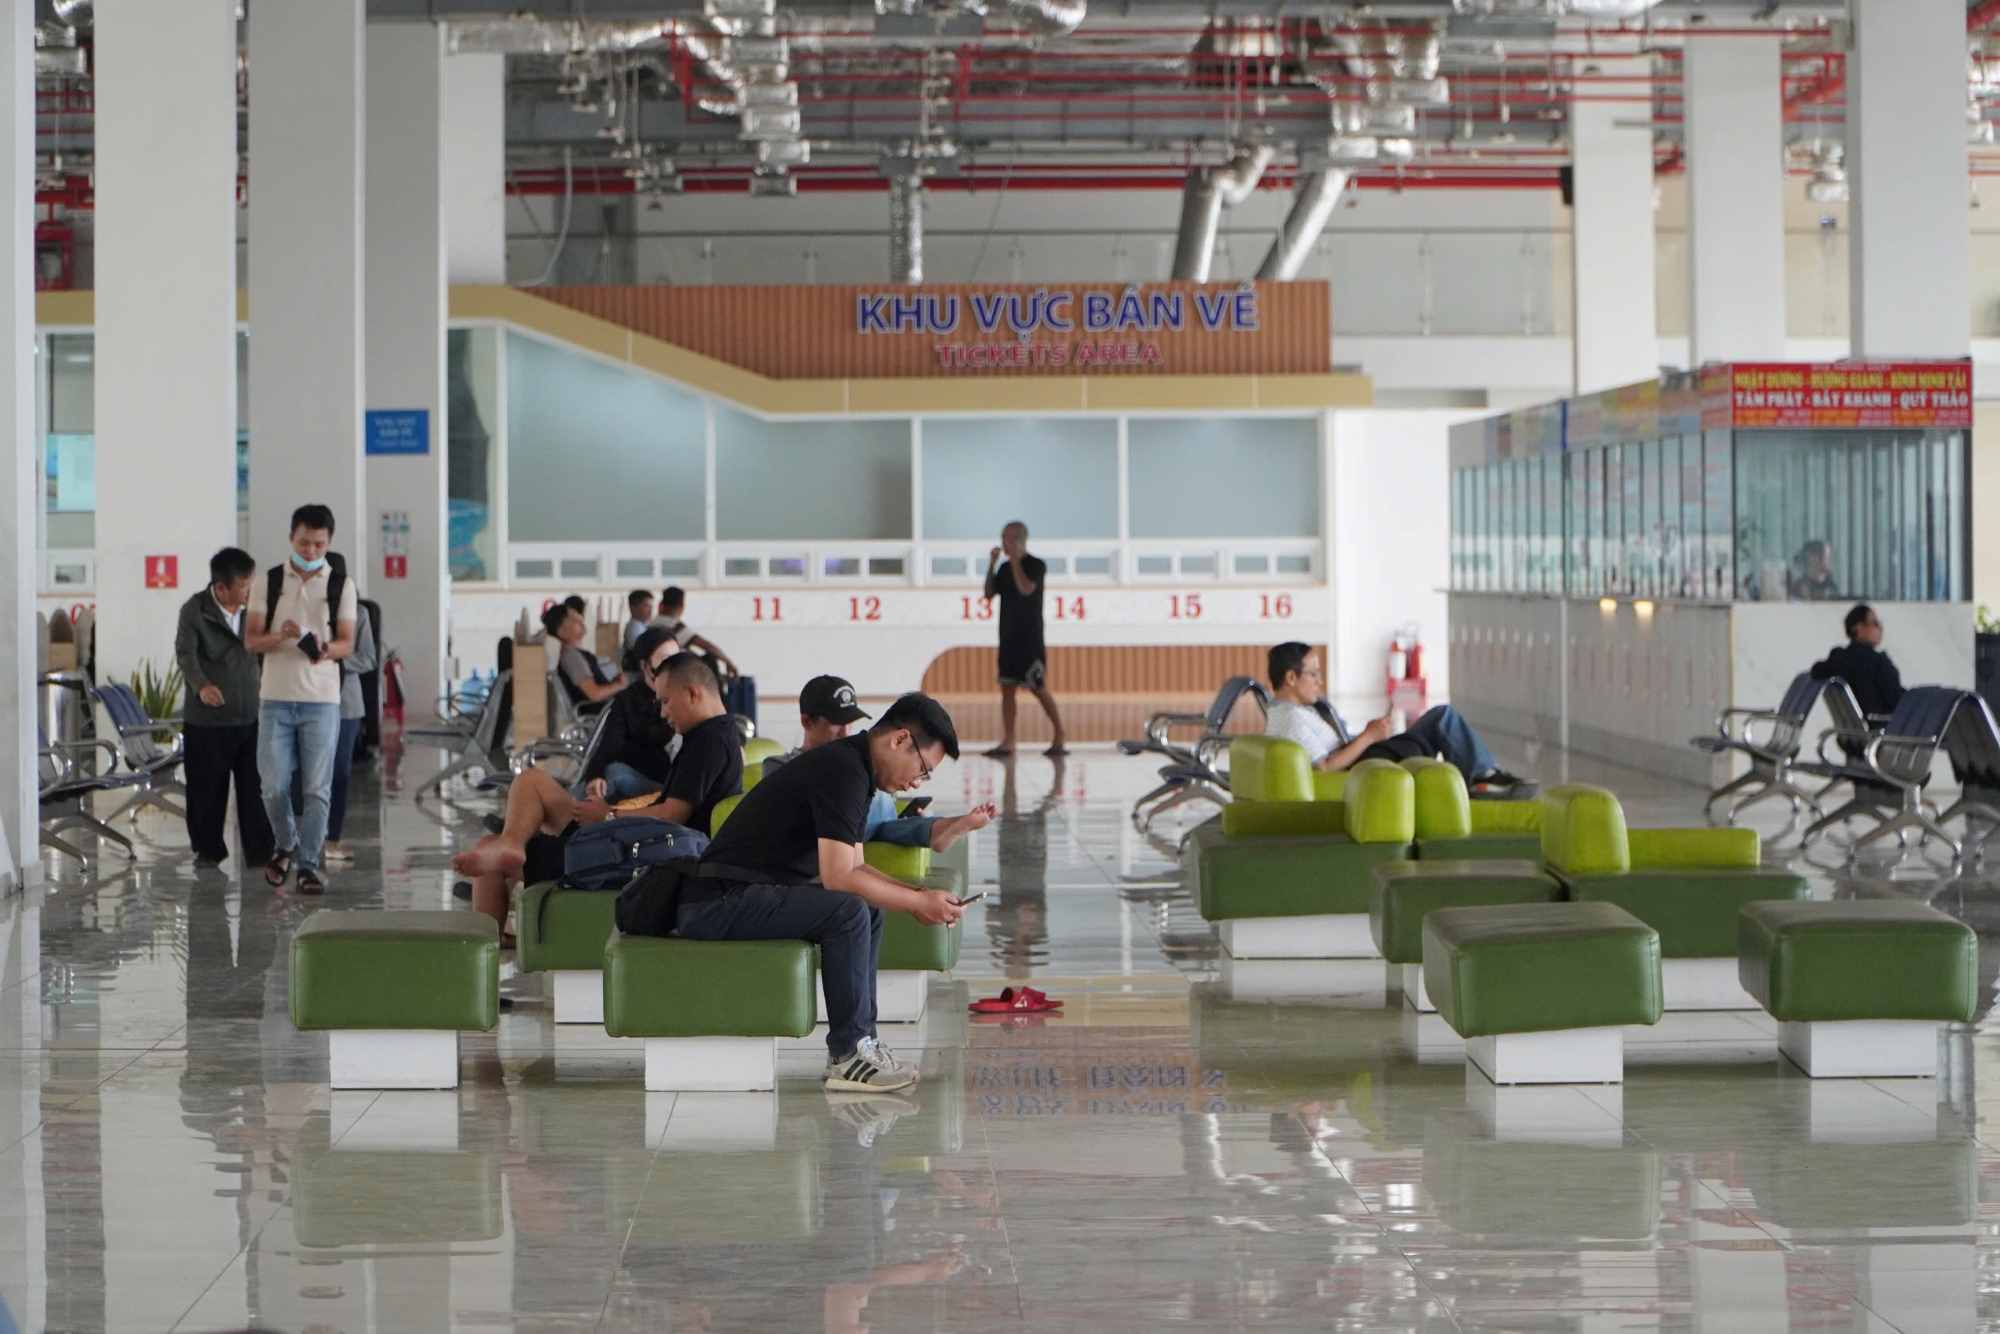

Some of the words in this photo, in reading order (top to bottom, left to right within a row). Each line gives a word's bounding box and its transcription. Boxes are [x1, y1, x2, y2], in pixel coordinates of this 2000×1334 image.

[857, 291, 959, 333] KHU
[970, 288, 1074, 343] VỰC
[1084, 283, 1184, 332] BÁN
[1194, 281, 1260, 331] VÉ
[936, 344, 1070, 368] TICKETS
[1077, 344, 1164, 368] AREA
[751, 597, 784, 621] 11
[848, 597, 882, 621] 12
[960, 597, 994, 621] 13
[1054, 597, 1087, 621] 14
[1168, 595, 1203, 619] 15
[1258, 595, 1293, 619] 16
